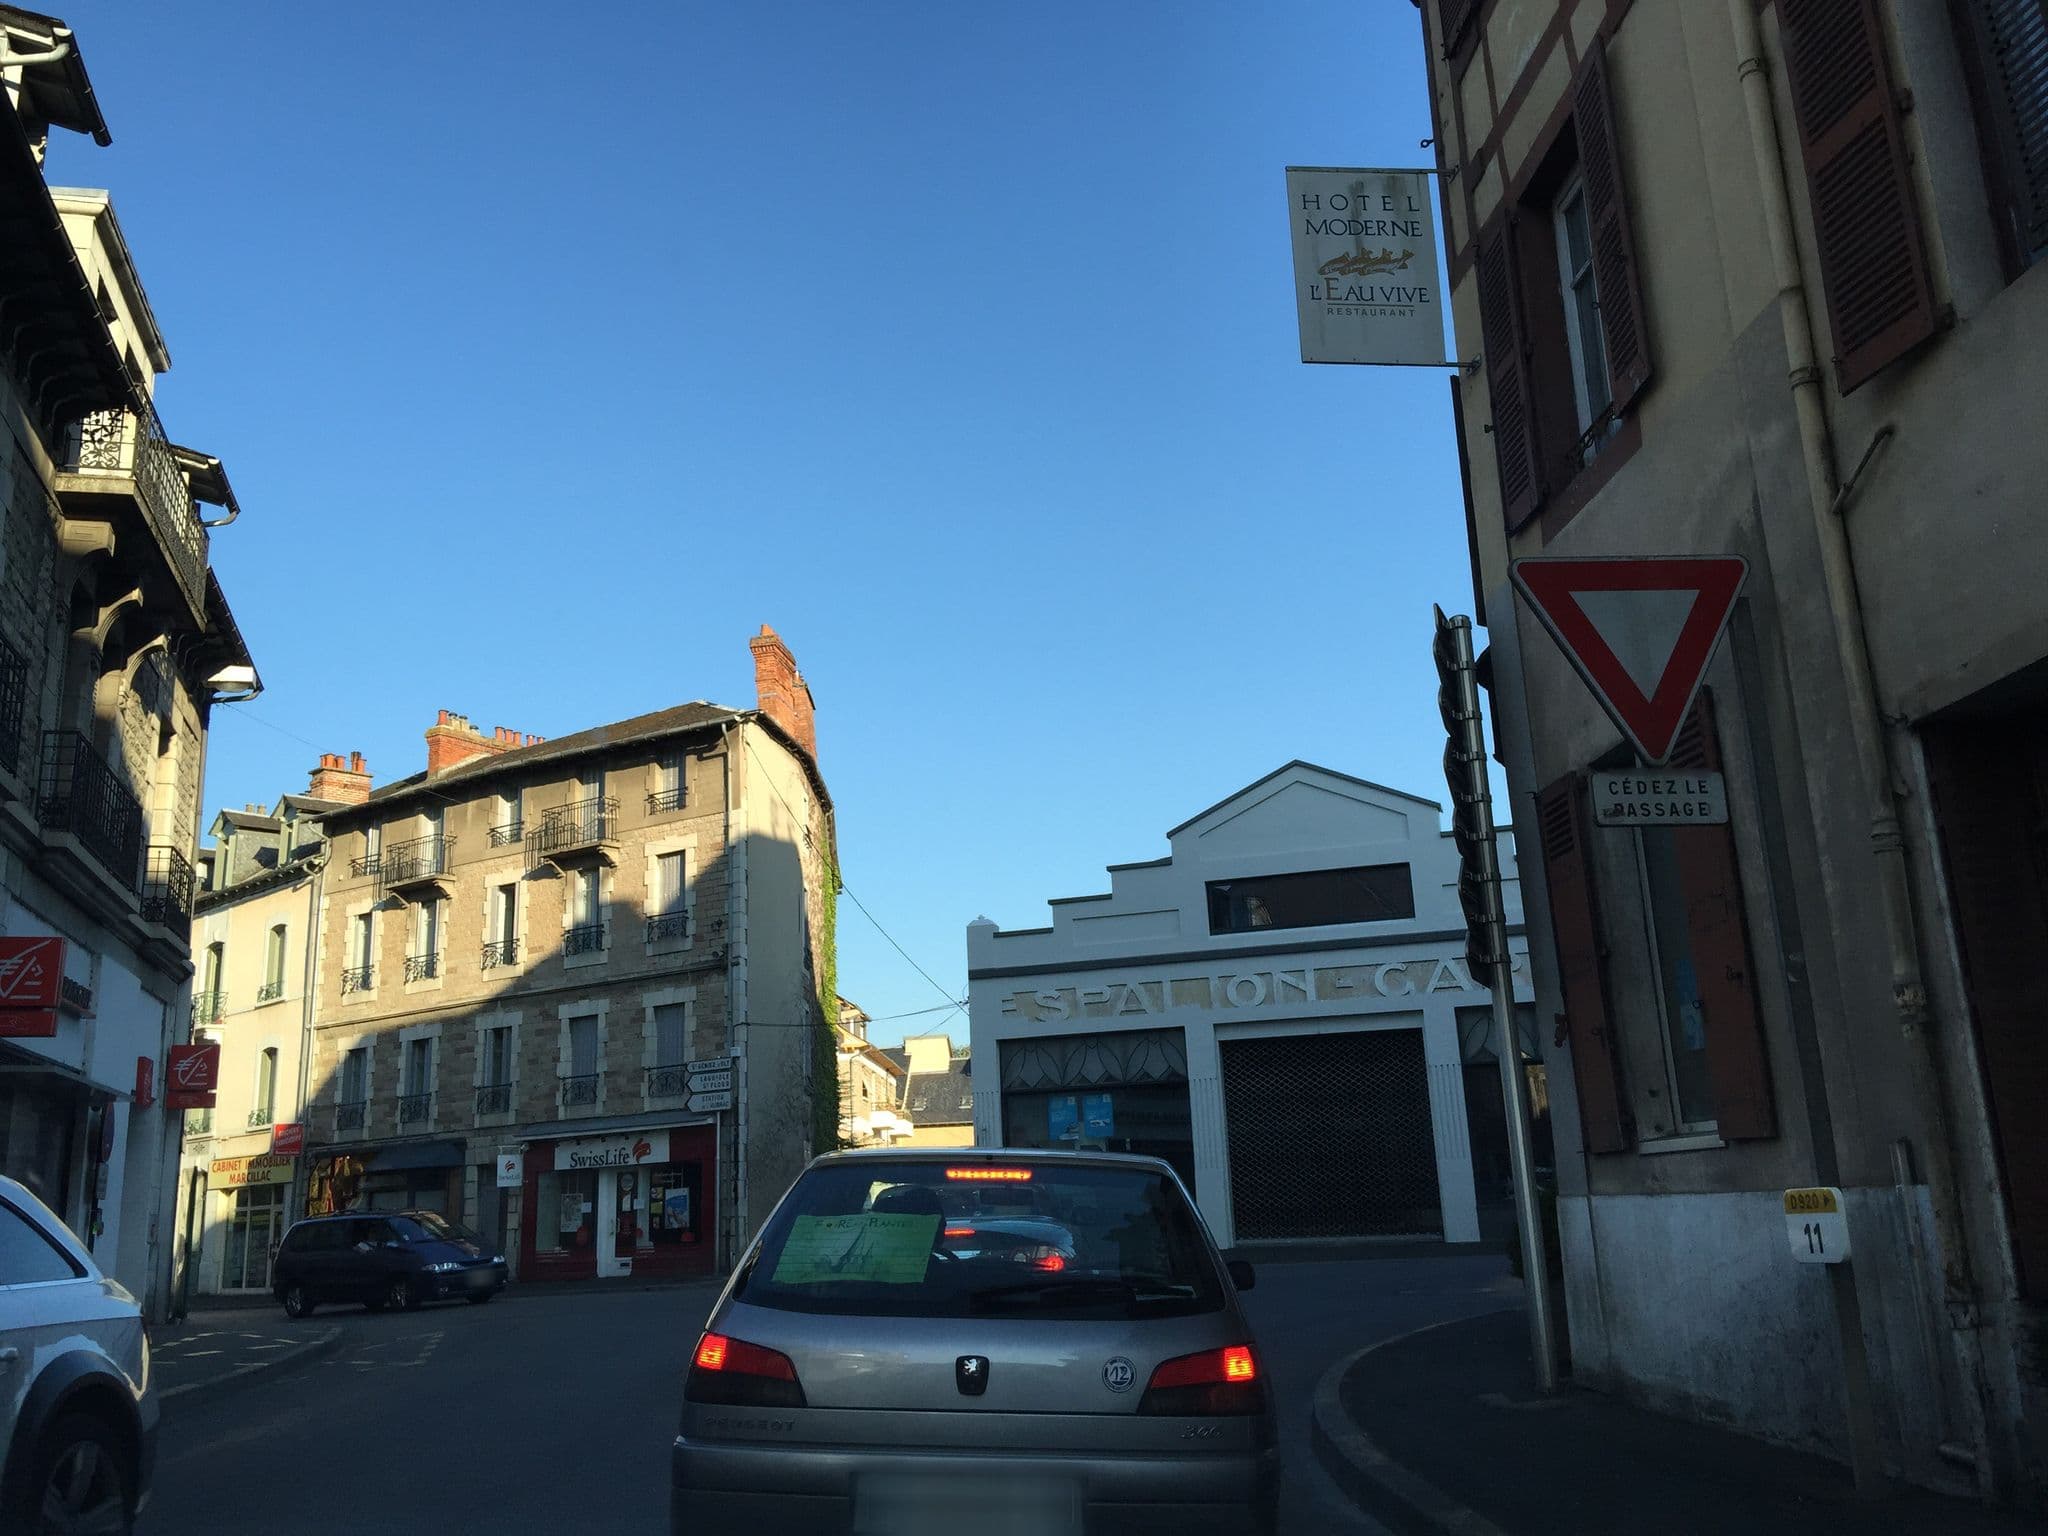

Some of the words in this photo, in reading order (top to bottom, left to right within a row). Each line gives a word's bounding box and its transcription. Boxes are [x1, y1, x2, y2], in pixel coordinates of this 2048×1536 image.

[1302, 194, 1420, 212] HOTEL
[1305, 219, 1423, 238] MODERNE
[1380, 287, 1430, 304] VIVE
[1327, 307, 1417, 318] RESTAURANT
[1608, 778, 1677, 796] CÉDEZ
[1685, 780, 1709, 795] LE
[211, 1160, 241, 1173] CABINET
[245, 1156, 291, 1170] IMMOBILIER
[570, 1147, 630, 1169] SwissLife
[229, 1170, 271, 1184] MARCILLAC
[1804, 1223, 1824, 1254] 11
[1110, 1366, 1130, 1381] 12
